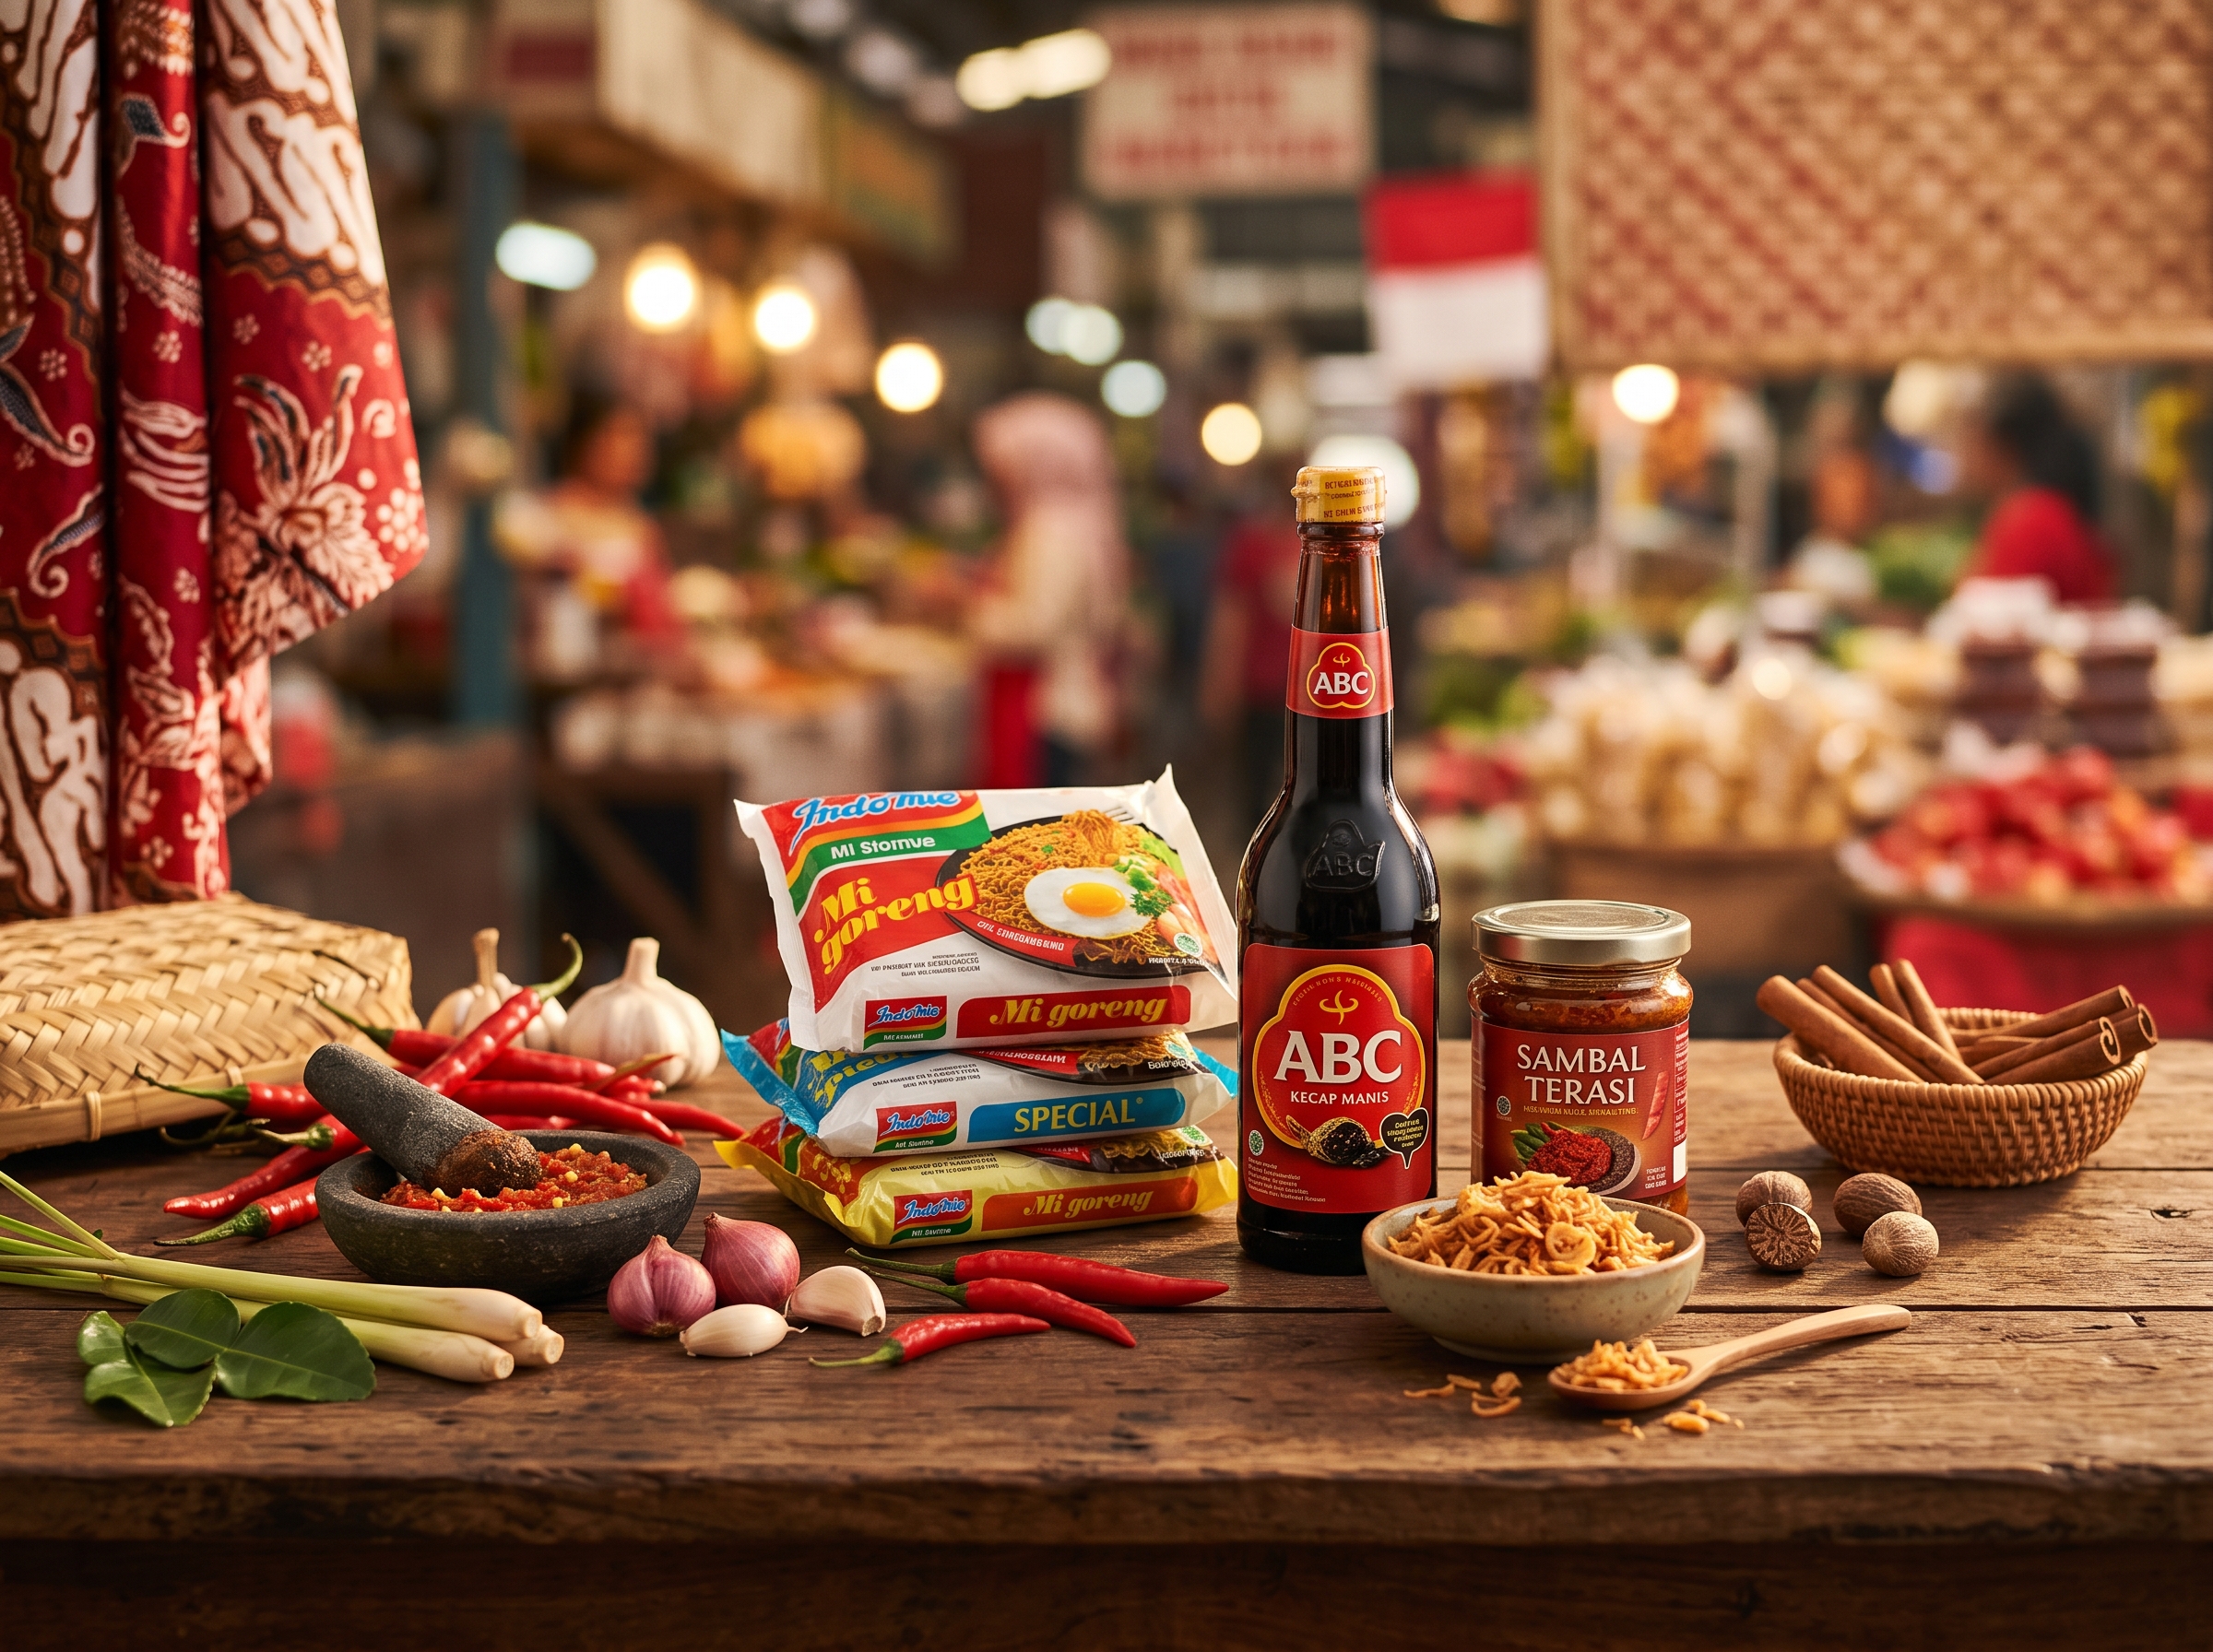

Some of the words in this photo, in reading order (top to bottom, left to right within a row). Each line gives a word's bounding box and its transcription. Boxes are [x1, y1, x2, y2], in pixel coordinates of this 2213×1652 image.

[1313, 671, 1369, 695] ABC
[1312, 852, 1375, 877] ABC
[814, 878, 877, 943] Mi
[822, 877, 976, 975] goreng
[989, 997, 1044, 1025] Mi
[1046, 998, 1168, 1028] goreng
[1273, 1030, 1402, 1084] ABC
[1517, 1044, 1646, 1073] SAMBAL
[1290, 1091, 1338, 1105] KECAP
[1341, 1091, 1390, 1105] MANIS
[1523, 1075, 1635, 1104] TERASI
[1013, 1099, 1136, 1133] SPECIAL
[1023, 1193, 1065, 1216] Mi
[1064, 1190, 1154, 1219] goreng
